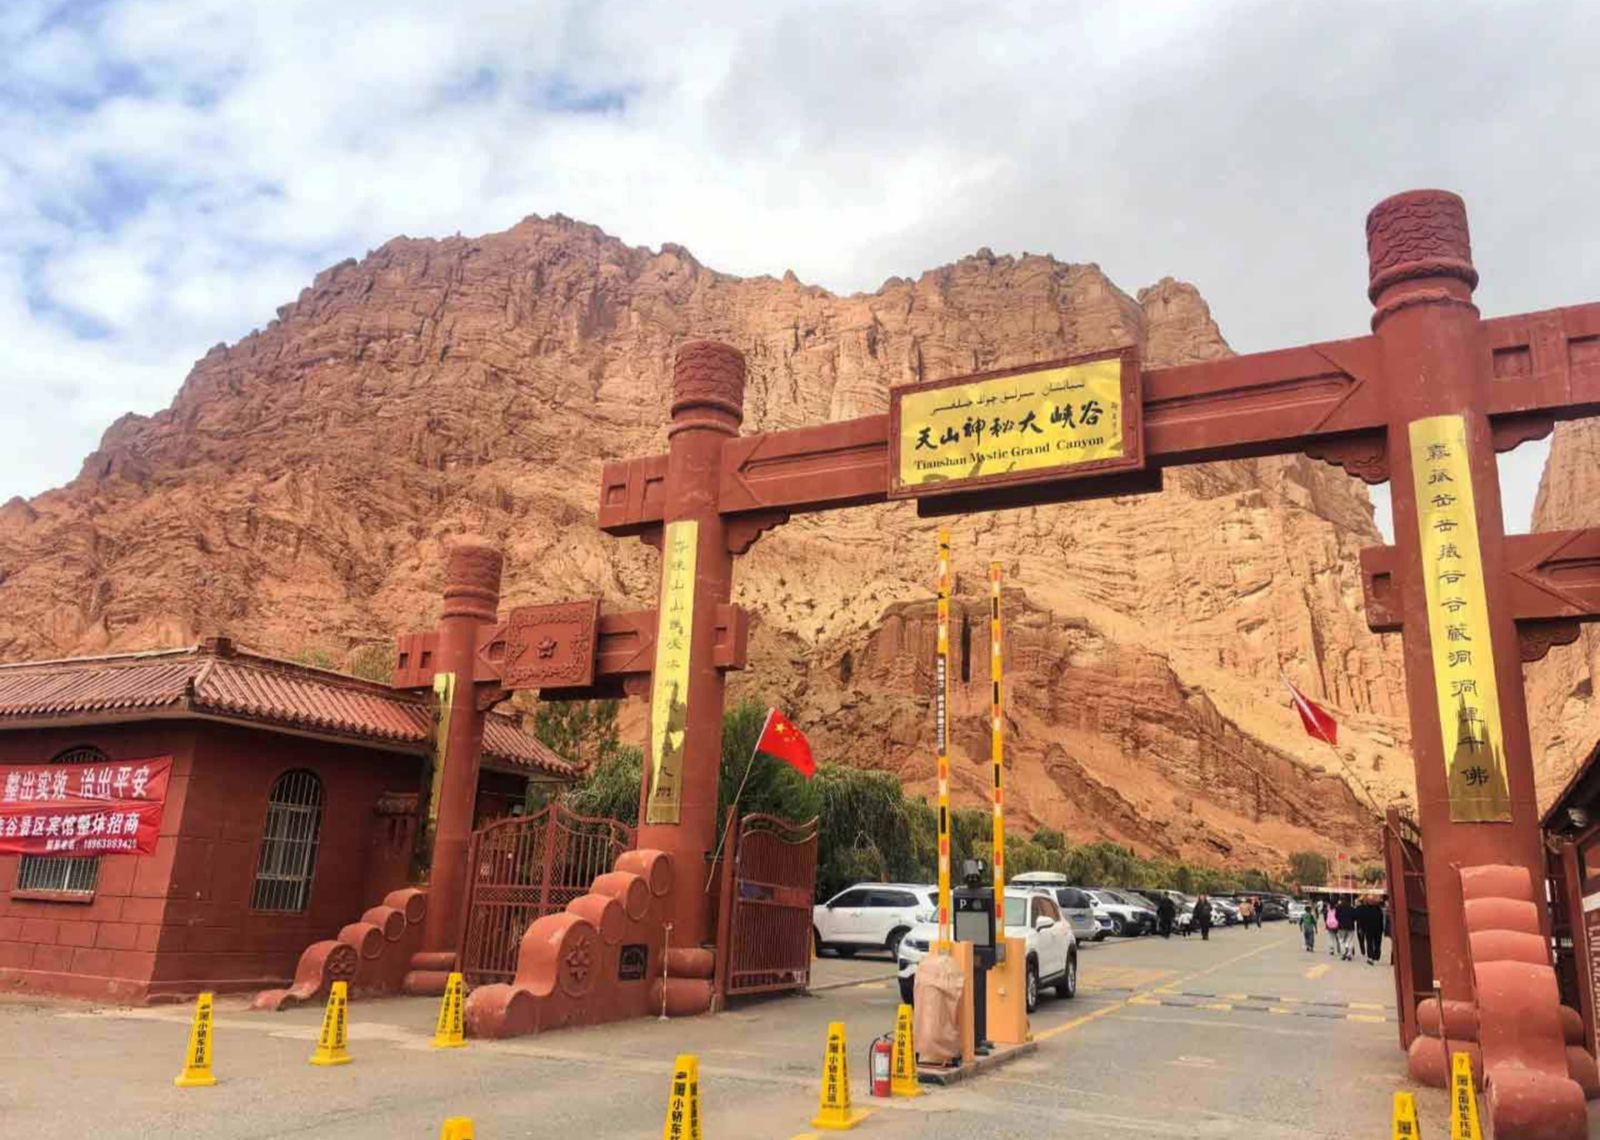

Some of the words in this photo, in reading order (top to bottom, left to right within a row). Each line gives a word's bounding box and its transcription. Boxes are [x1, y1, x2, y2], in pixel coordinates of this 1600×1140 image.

[915, 400, 1104, 450] 天山神秘大峡谷
[914, 456, 967, 470] Tianshan
[970, 448, 1009, 464] Mystic
[1011, 442, 1050, 457] Grand
[1056, 436, 1104, 450] Canyon
[80, 765, 150, 799] 治出平安
[959, 898, 967, 909] P
